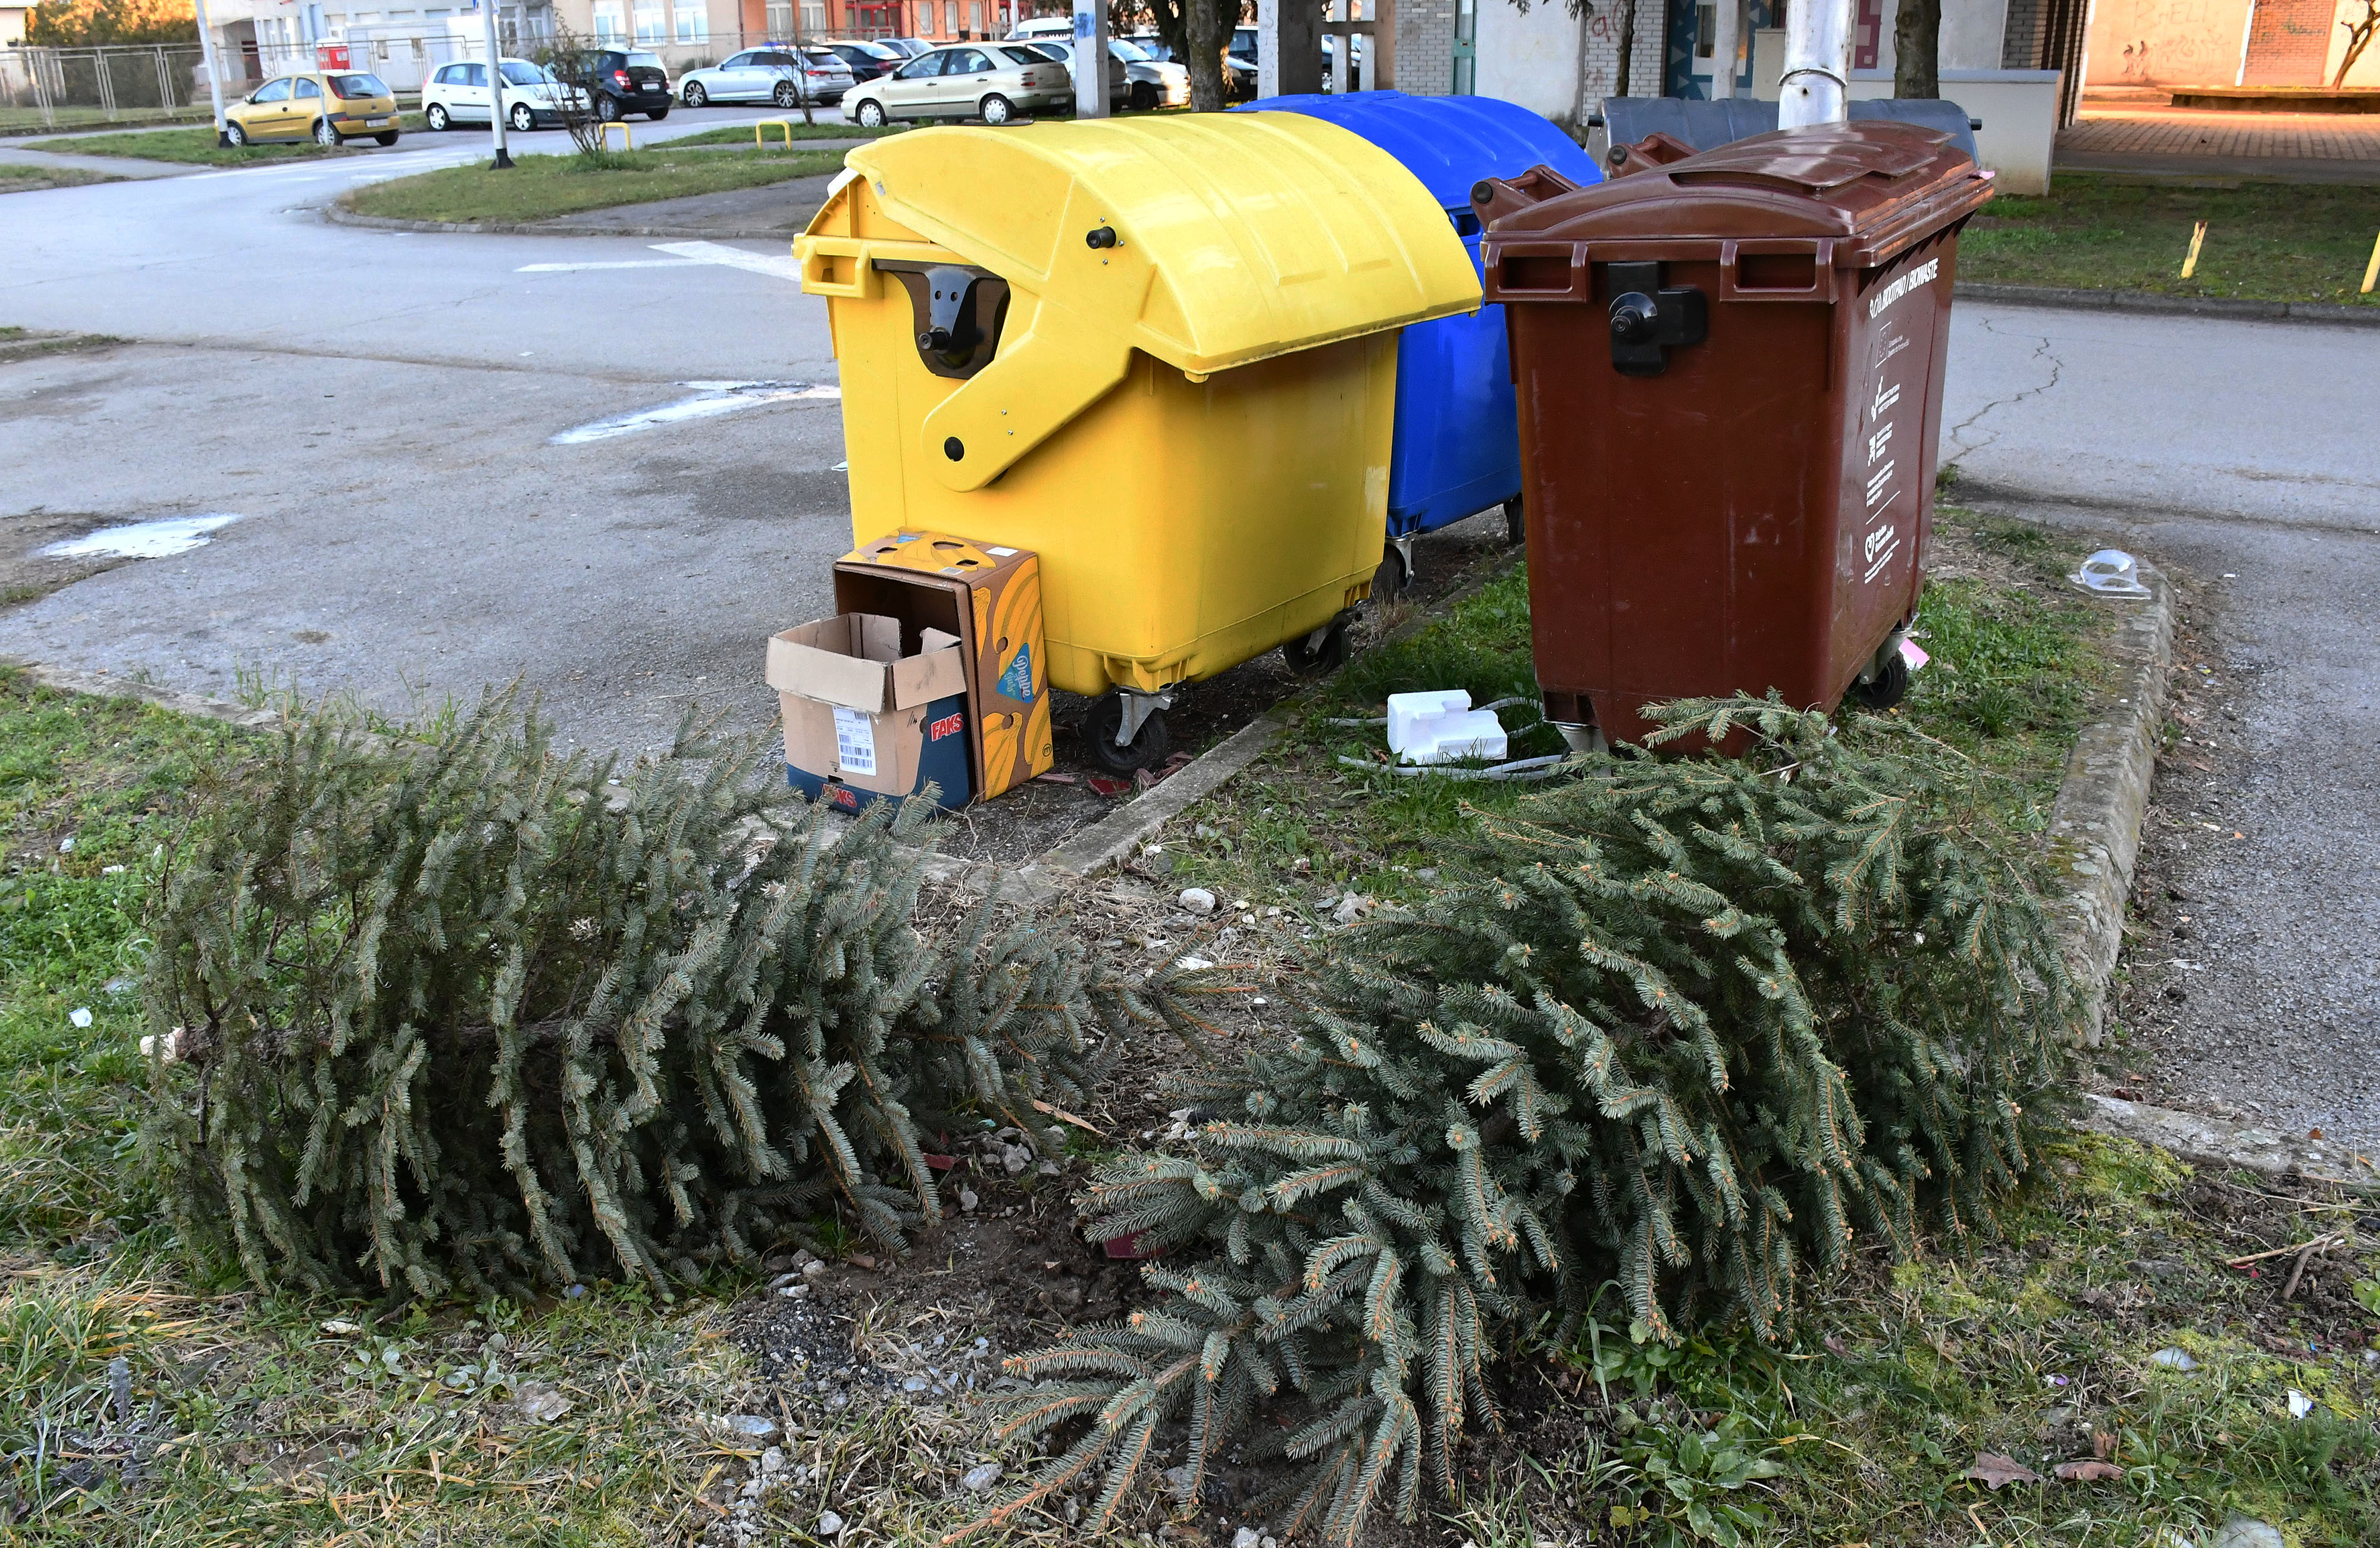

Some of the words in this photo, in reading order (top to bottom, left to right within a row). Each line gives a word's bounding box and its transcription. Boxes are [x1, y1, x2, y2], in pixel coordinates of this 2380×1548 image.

[1908, 258, 1939, 291] BIOWASTE
[1013, 655, 1031, 698] Peppe
[931, 712, 964, 742] FAKS
